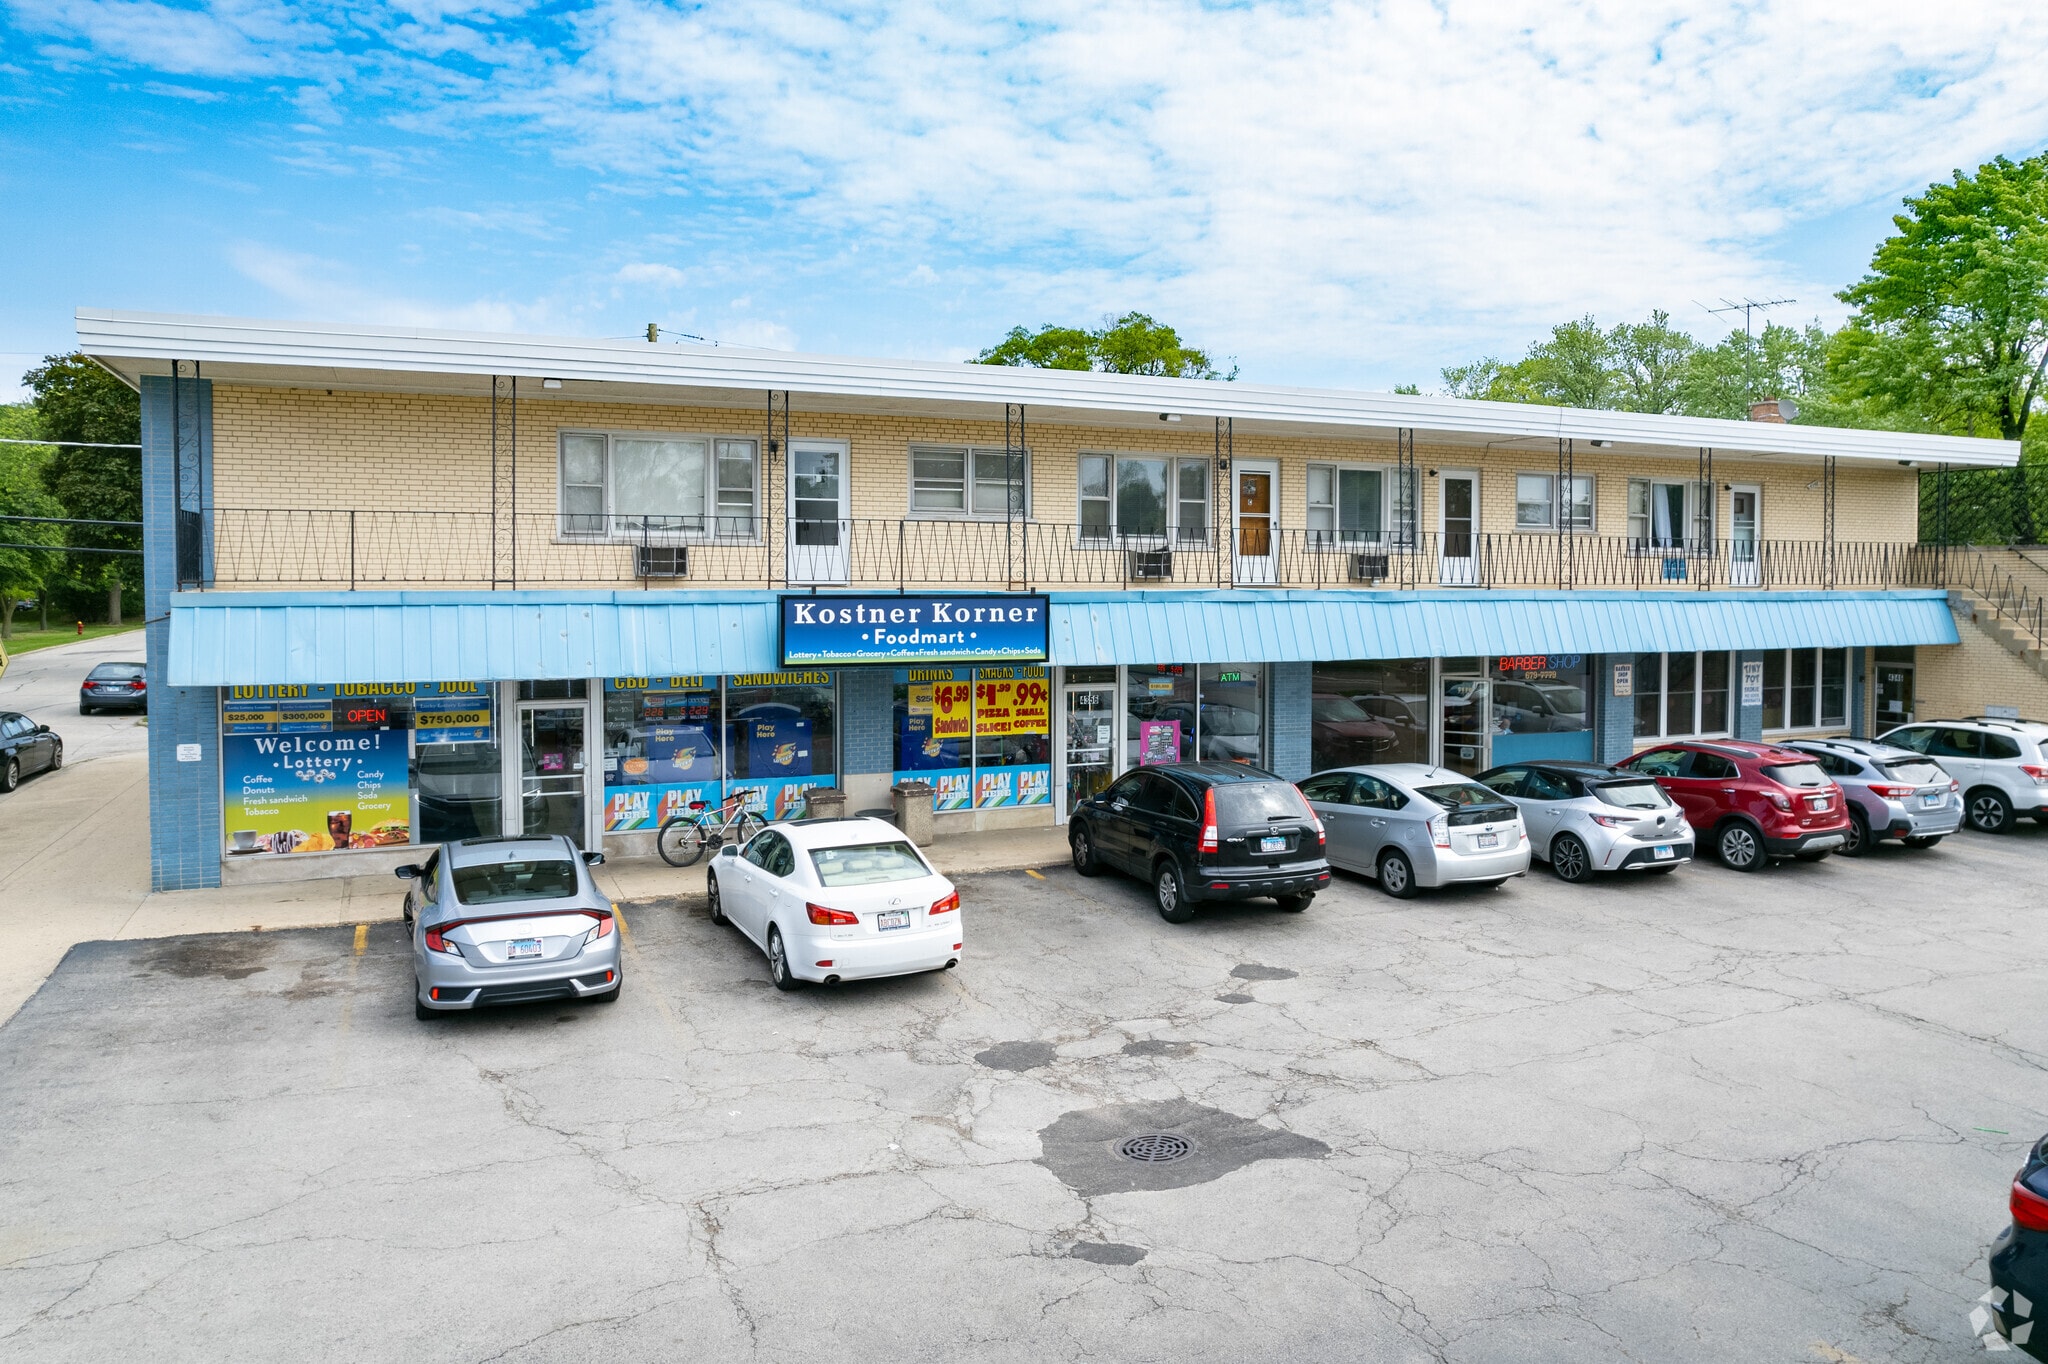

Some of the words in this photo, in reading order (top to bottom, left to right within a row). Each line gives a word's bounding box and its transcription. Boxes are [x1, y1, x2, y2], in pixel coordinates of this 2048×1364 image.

[793, 603, 921, 624] Kostner
[932, 602, 1038, 623] Korner
[874, 628, 965, 645] Foodmart
[789, 651, 817, 660] Lottery
[822, 650, 852, 658] Tobacco
[856, 650, 885, 659] Grocery
[890, 649, 915, 657] Coffee
[919, 648, 938, 656] Fresh
[939, 648, 971, 656] sandwich
[975, 647, 997, 656] Candy
[1001, 647, 1021, 656] Chips
[1024, 646, 1042, 654] Soda
[1499, 656, 1547, 671] BARBER
[1548, 654, 1580, 669] SHOP
[1744, 664, 1761, 674] TINY
[733, 671, 829, 686] SANDWICHES
[1220, 673, 1240, 682] ATM
[1745, 674, 1760, 683] TOT
[916, 695, 933, 703] $25
[935, 685, 969, 714] $6.99
[976, 683, 1011, 706] $1.99
[282, 712, 325, 720] $300,000
[347, 709, 387, 722] OPEN
[977, 708, 1010, 718] PIZZA
[1016, 708, 1045, 716] SMALL
[420, 714, 480, 725] $750,000
[1013, 719, 1047, 728] COFFEE
[757, 724, 775, 732] Play
[935, 717, 969, 734] Sandwich
[976, 722, 1011, 733] SLICE!
[655, 728, 674, 736] Play
[254, 734, 380, 754] Welcome!
[284, 755, 352, 771] Lottery
[243, 775, 273, 784] Coffee
[357, 770, 384, 780] Candy
[982, 772, 1011, 789] PLAY
[1020, 770, 1049, 787] PLAY
[357, 781, 381, 790] Chips
[940, 774, 970, 793] PLAY
[243, 786, 275, 794] Donuts
[357, 791, 378, 800] Soda
[243, 796, 268, 805] Fresh
[269, 794, 308, 804] sandwich
[614, 792, 650, 811] PLAY
[244, 807, 279, 816] Tobacco
[357, 802, 391, 811] Grocery
